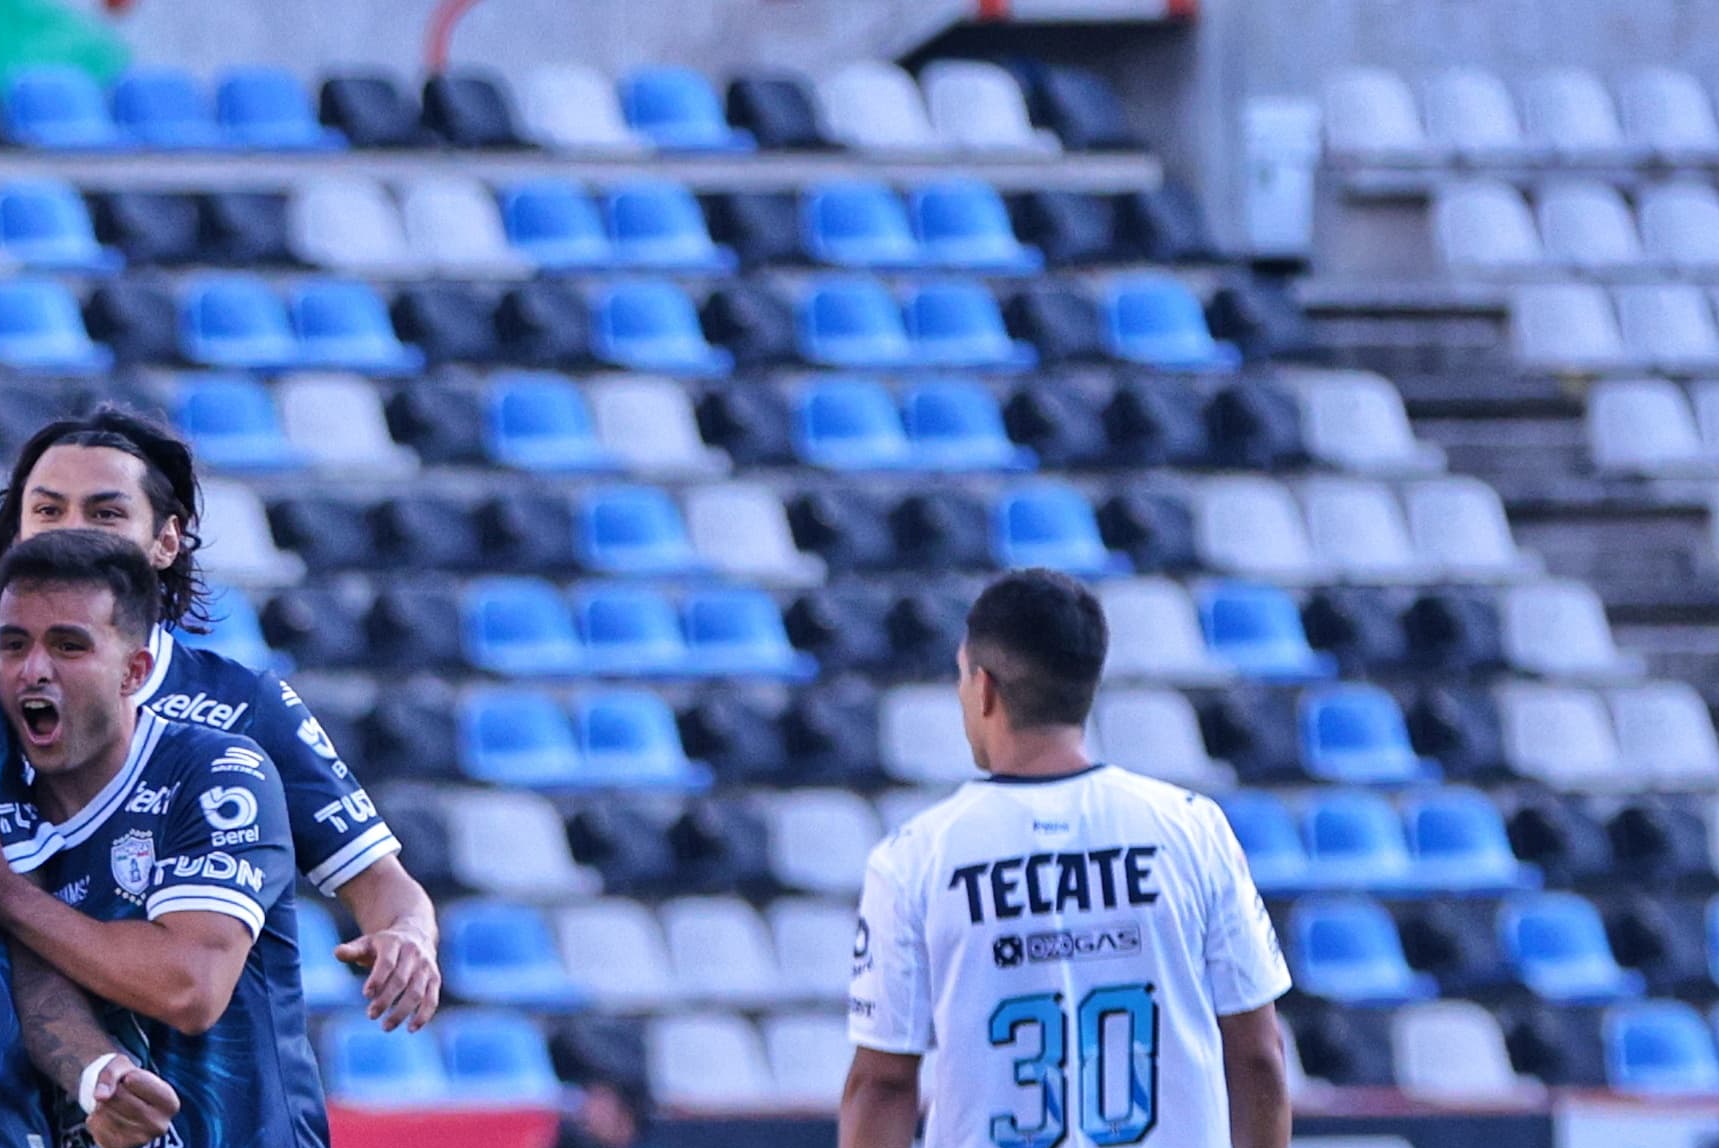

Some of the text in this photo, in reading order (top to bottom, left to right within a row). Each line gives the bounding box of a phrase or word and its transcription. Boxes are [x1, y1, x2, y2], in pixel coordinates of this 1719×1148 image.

[152, 693, 248, 730] telcel
[211, 824, 259, 846] Berel
[153, 851, 264, 893] TUDN
[948, 846, 1160, 925] TECATE
